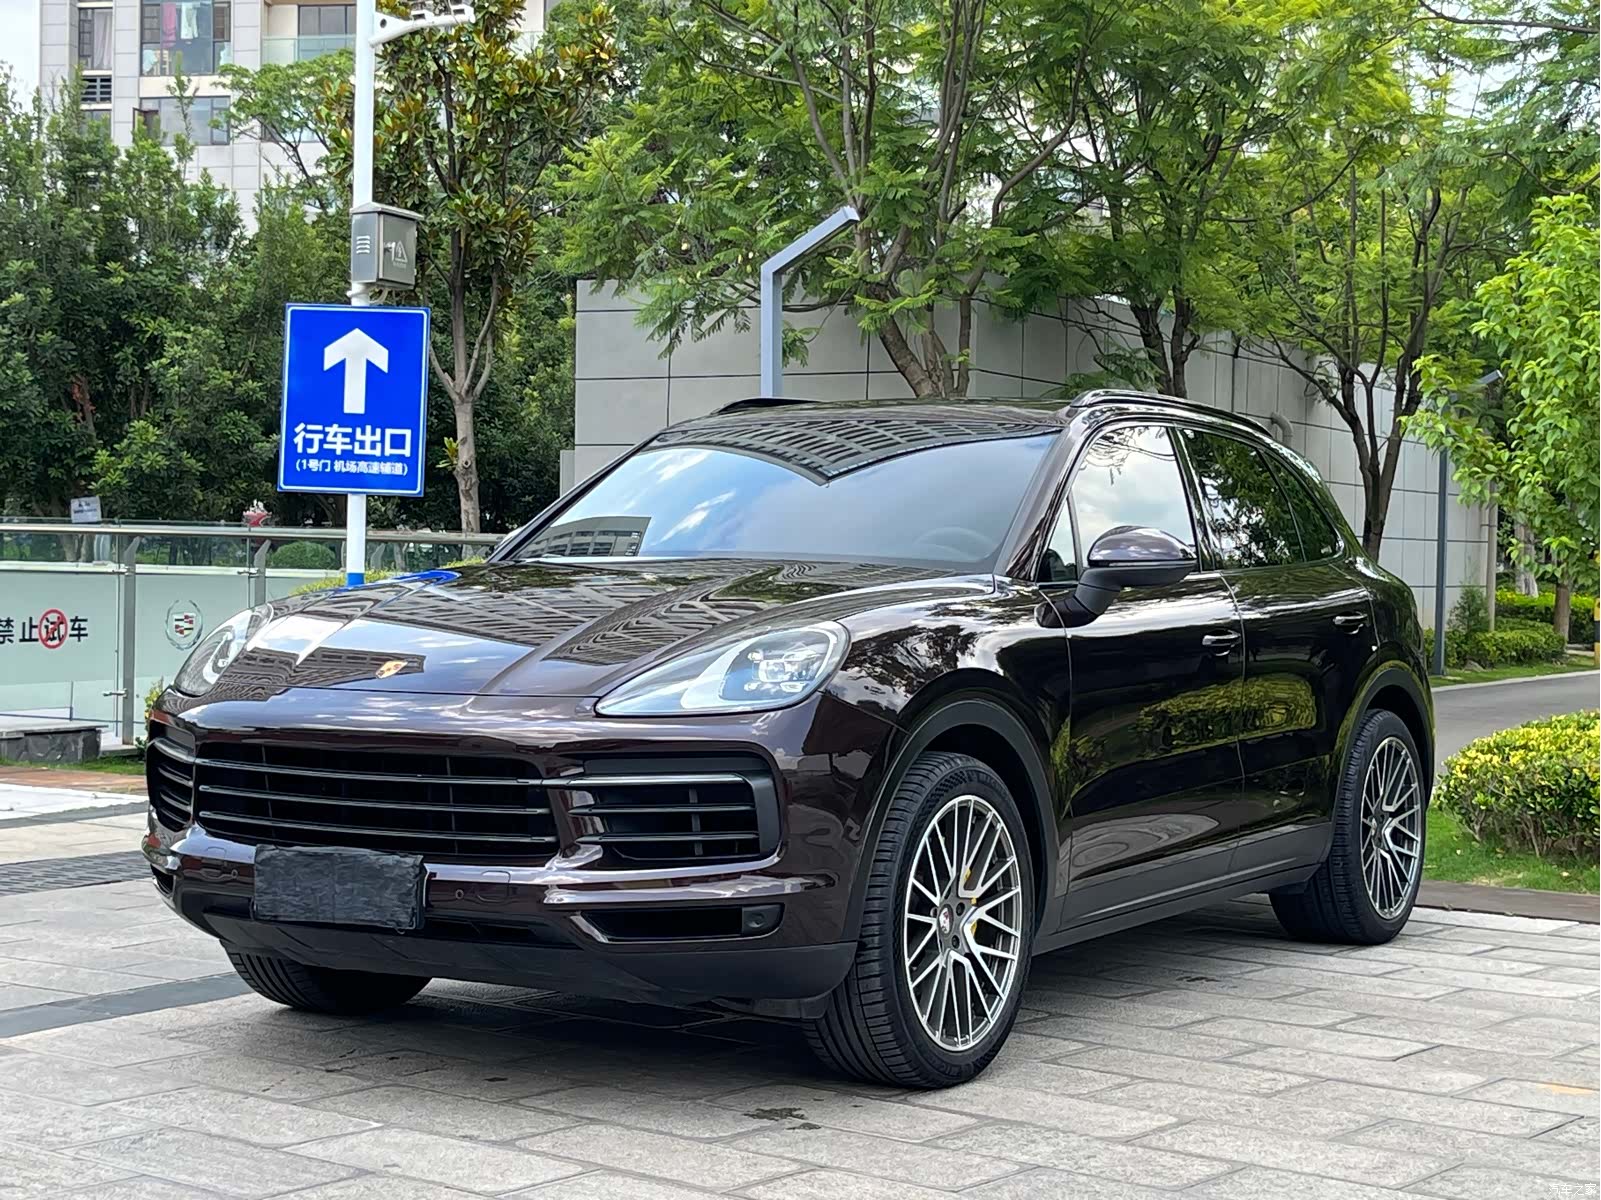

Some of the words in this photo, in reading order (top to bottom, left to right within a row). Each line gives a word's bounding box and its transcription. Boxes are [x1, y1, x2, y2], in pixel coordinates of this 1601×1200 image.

[293, 422, 412, 457] 行车出口
[296, 459, 331, 472] (1号门
